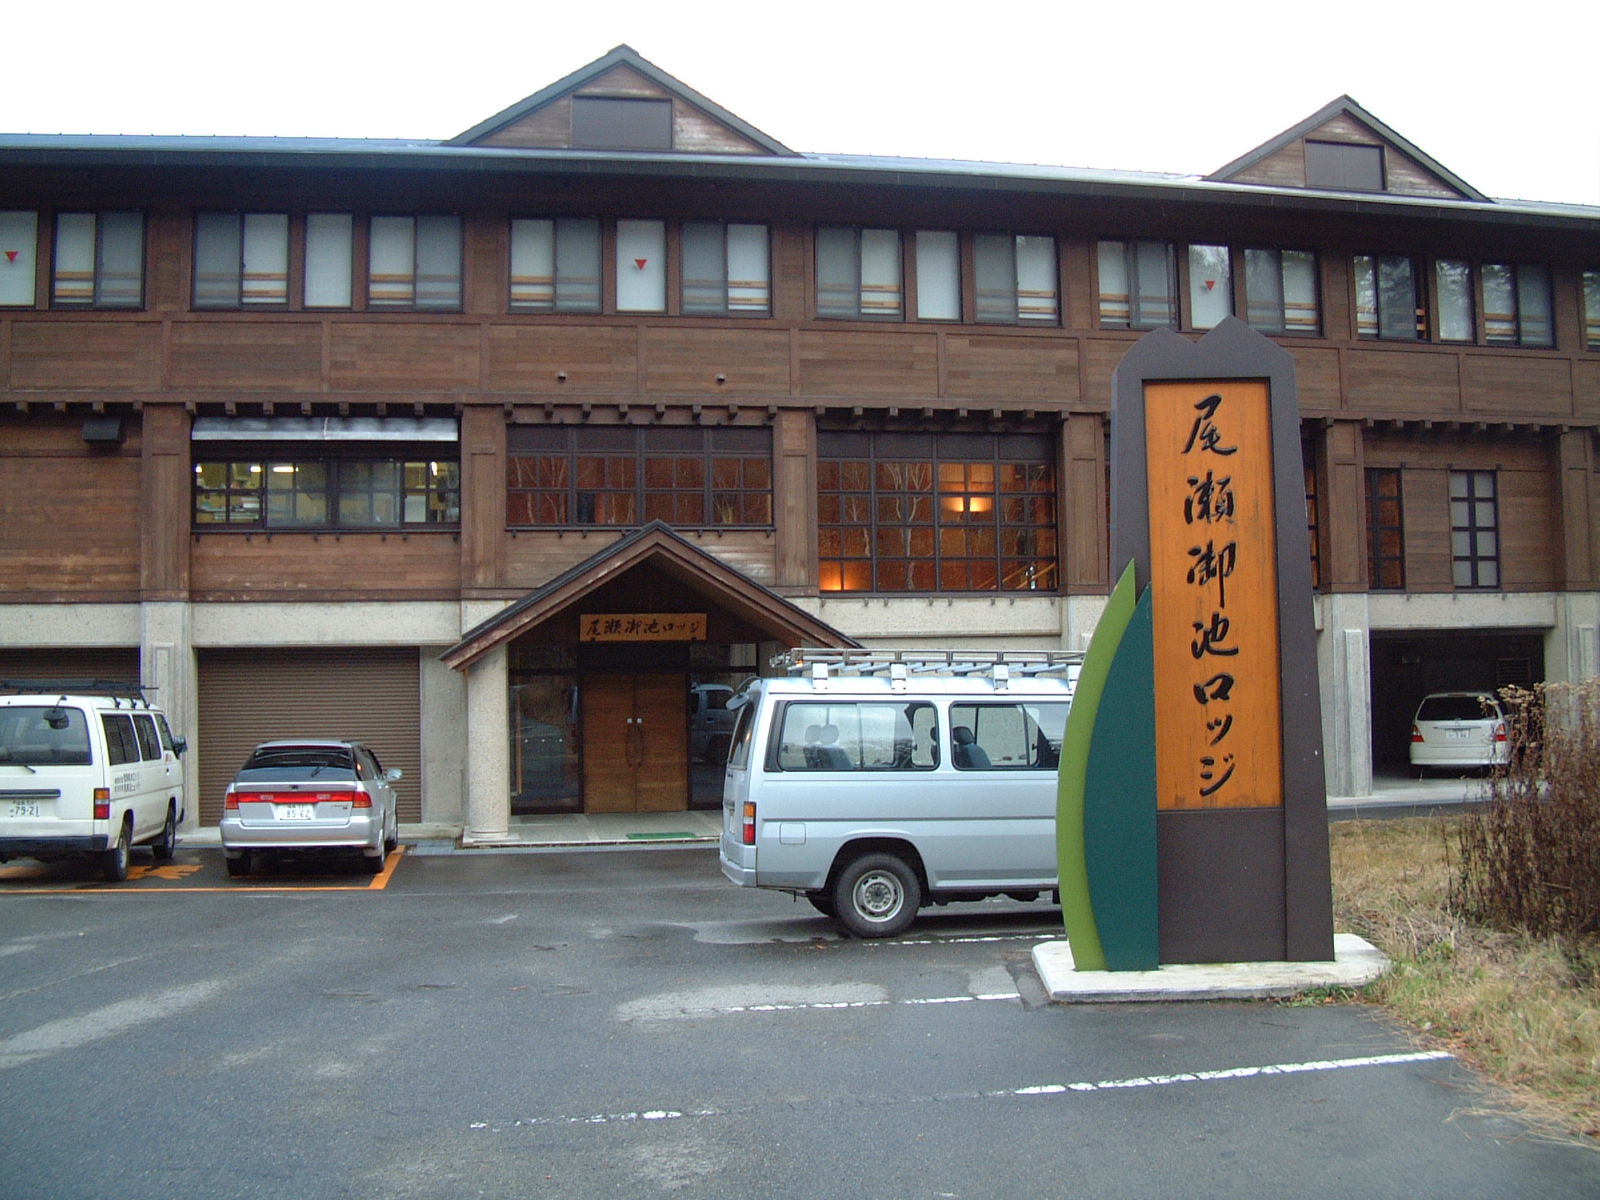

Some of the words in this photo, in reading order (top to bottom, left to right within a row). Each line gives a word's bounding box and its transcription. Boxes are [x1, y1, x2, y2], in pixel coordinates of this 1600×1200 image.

[586, 618, 700, 636] 尾瀬御池ロッジ
[1181, 394, 1239, 796] 尾瀬御池ロッジ
